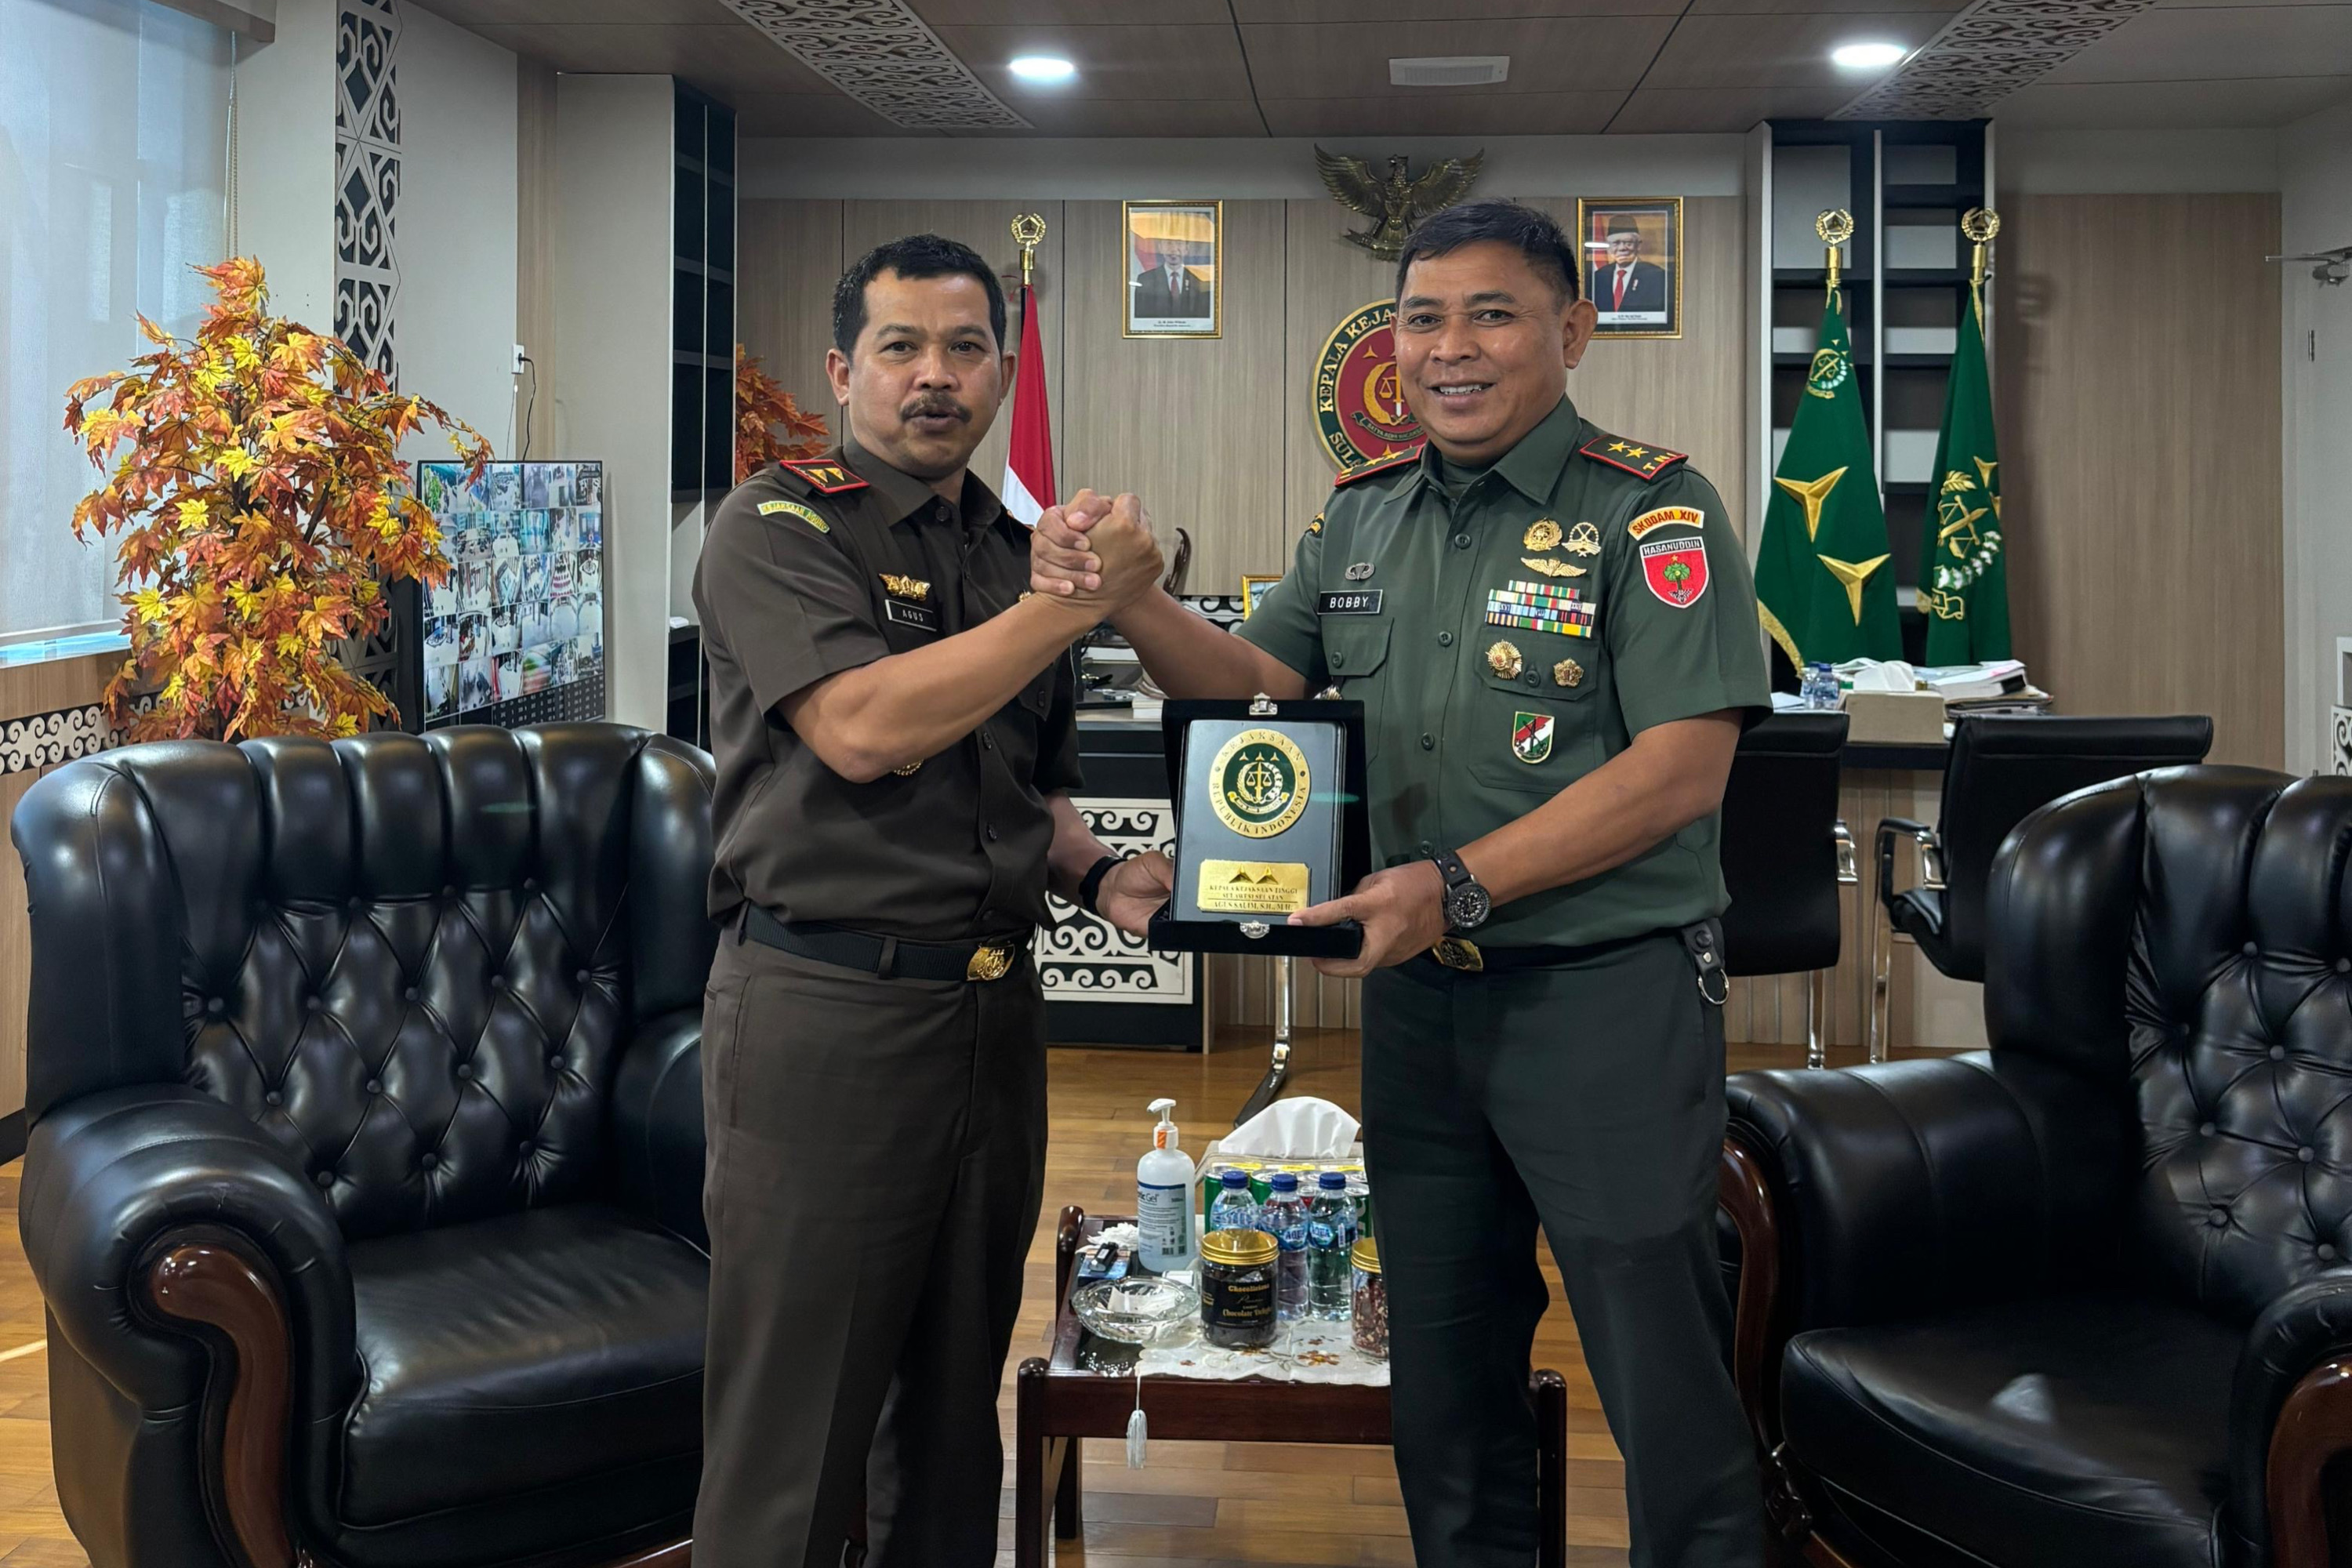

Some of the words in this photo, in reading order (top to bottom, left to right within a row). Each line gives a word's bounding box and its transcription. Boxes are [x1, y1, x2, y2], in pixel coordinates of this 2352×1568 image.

[1319, 342, 1348, 413] KEPALA
[1345, 308, 1393, 339] KEJA
[1632, 510, 1675, 534] SKODAM
[1679, 510, 1699, 523] XIV
[1643, 539, 1700, 556] HASANUDDIN
[1330, 596, 1369, 608] BOBBY
[902, 609, 924, 622] AGUS
[1223, 732, 1302, 760] KEJAKSAAN
[1212, 782, 1250, 833] REPUBLIK
[1255, 786, 1306, 834] INDONESIA
